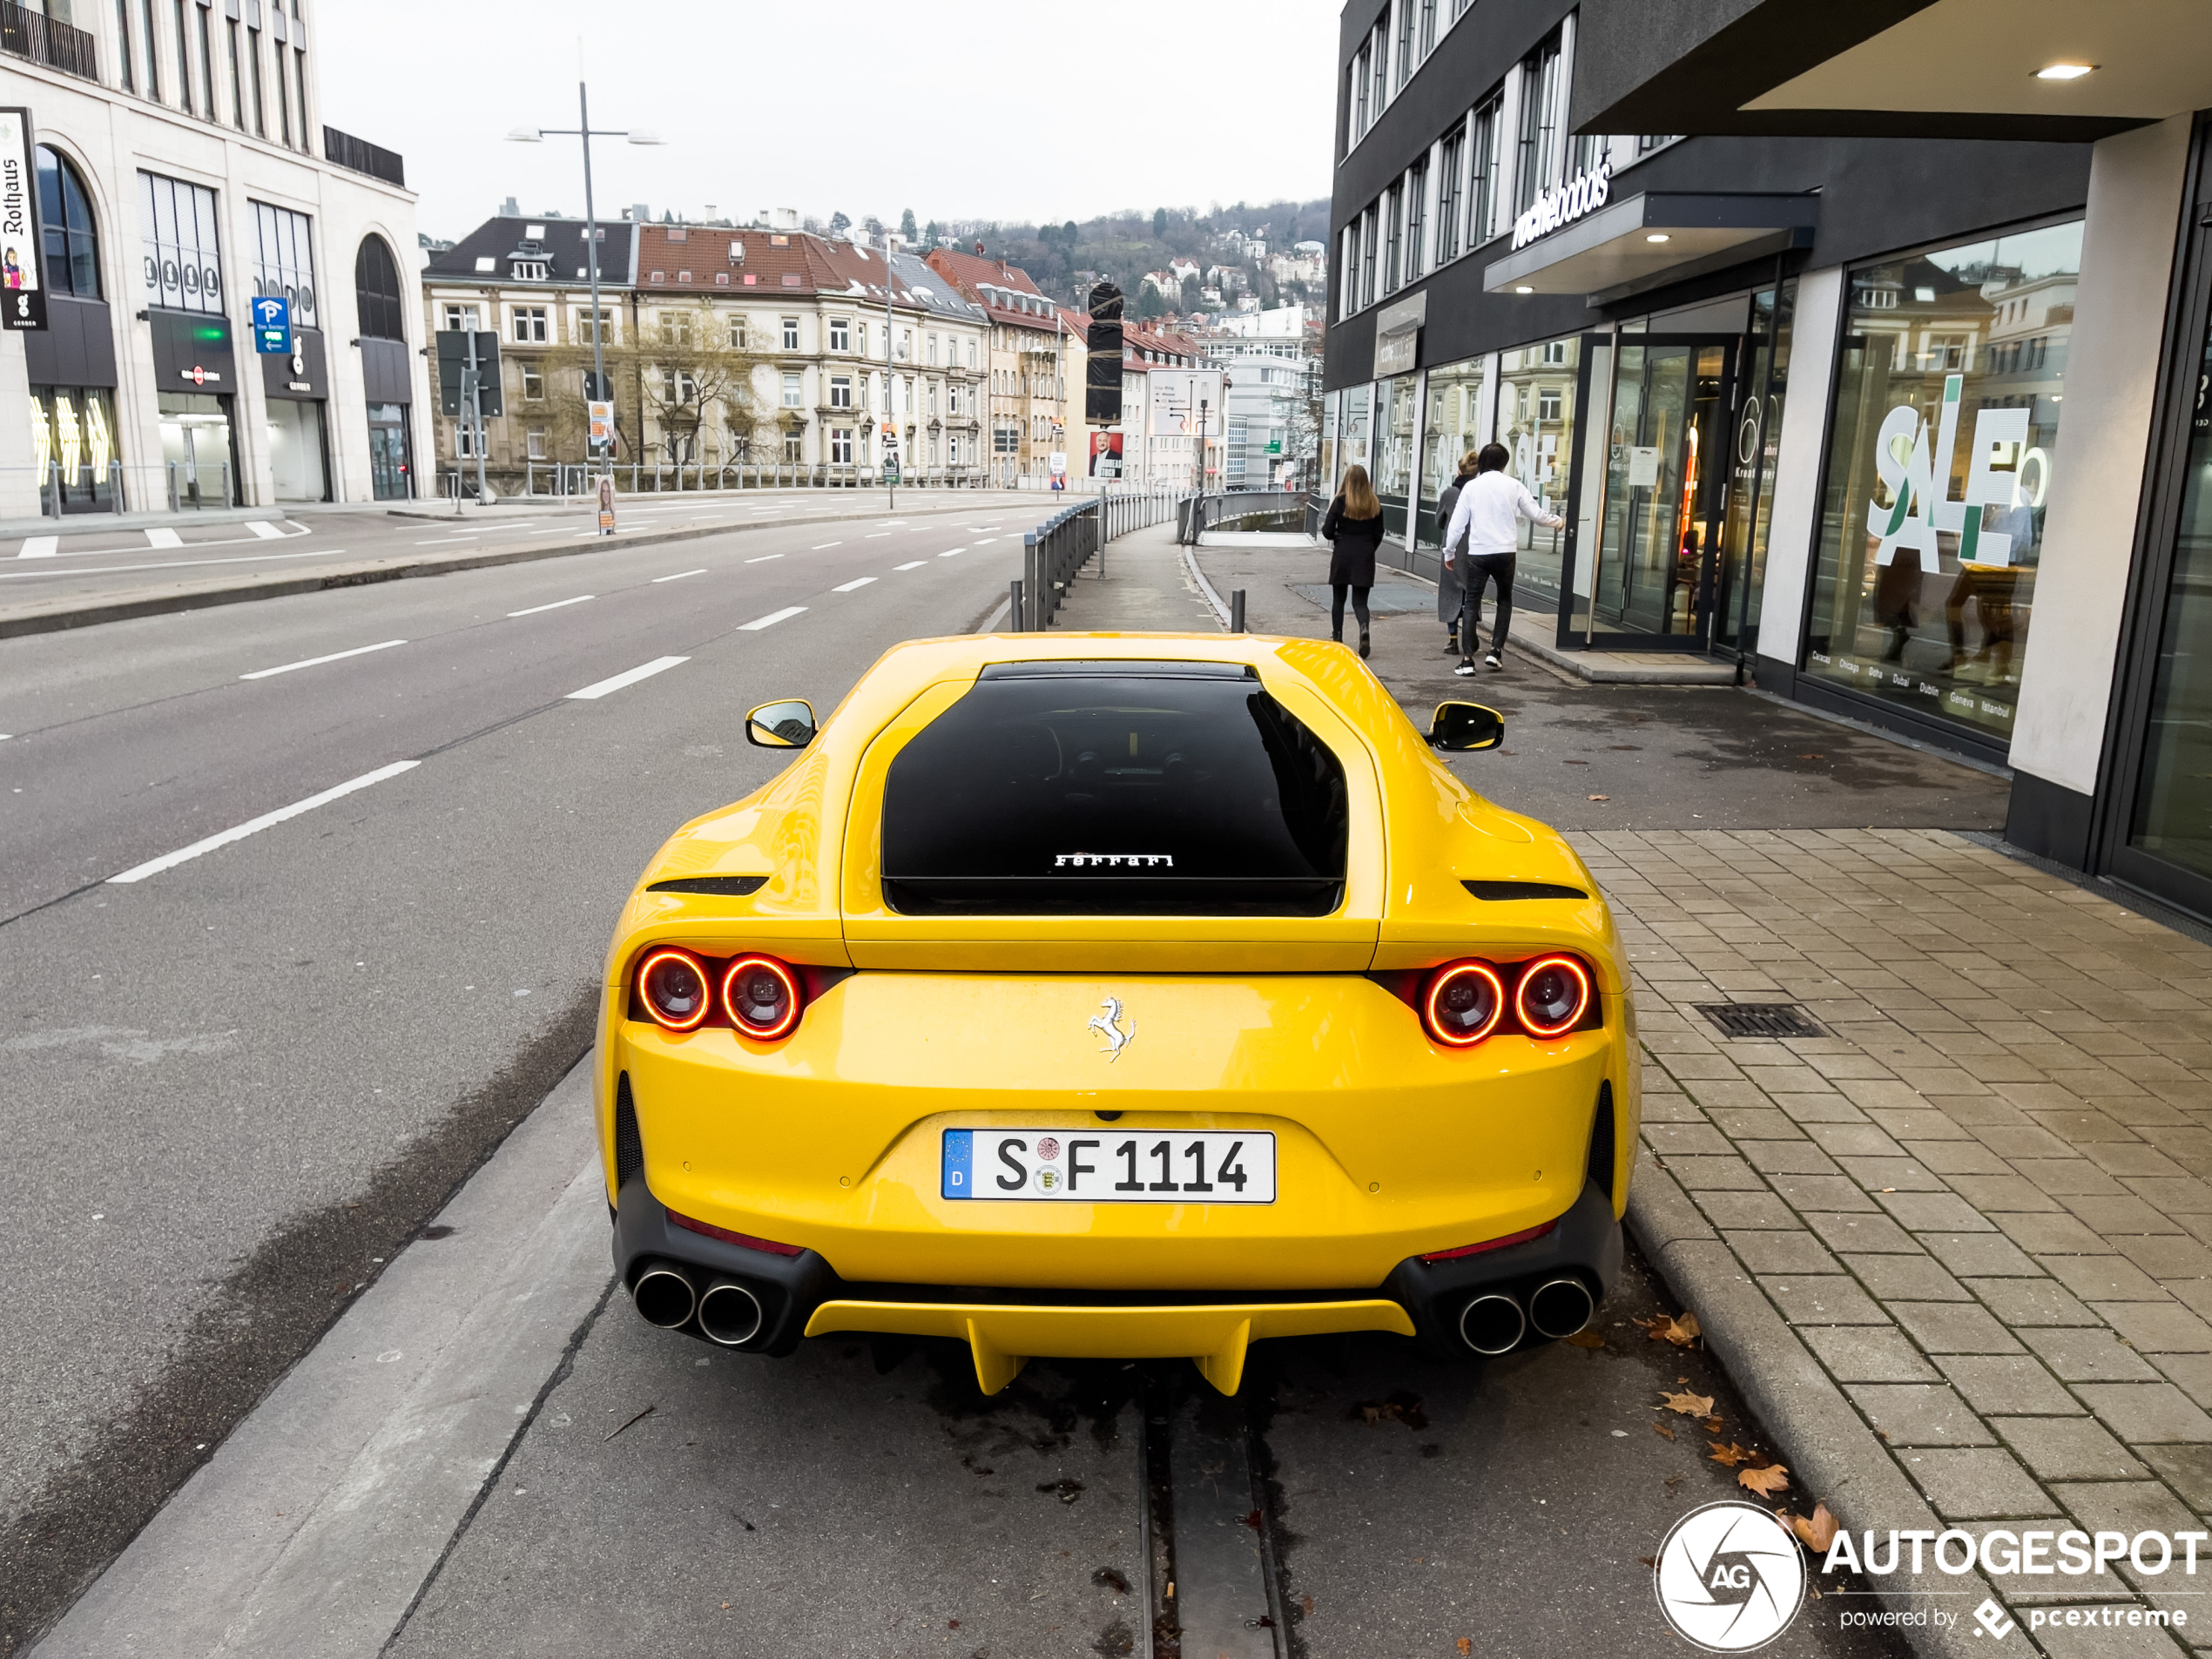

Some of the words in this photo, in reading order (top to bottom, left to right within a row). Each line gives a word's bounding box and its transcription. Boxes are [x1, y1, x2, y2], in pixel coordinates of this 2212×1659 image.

[3, 159, 24, 236] Rothaus
[1511, 154, 1610, 251] rochebobois
[1866, 374, 2031, 574] SALE
[1811, 651, 1831, 664] Caracas
[1838, 658, 1860, 674] Chicago
[1868, 666, 1883, 679] Doha
[1892, 673, 1910, 687] Dubai
[1919, 682, 1939, 697] Dublin
[1950, 691, 1974, 709] Geneva
[1981, 700, 2010, 718] Istanbul
[1055, 854, 1174, 867] Ferrari
[951, 1170, 963, 1186] D
[995, 1138, 1028, 1191] S
[1068, 1140, 1100, 1191] F
[1115, 1140, 1247, 1192] 1114
